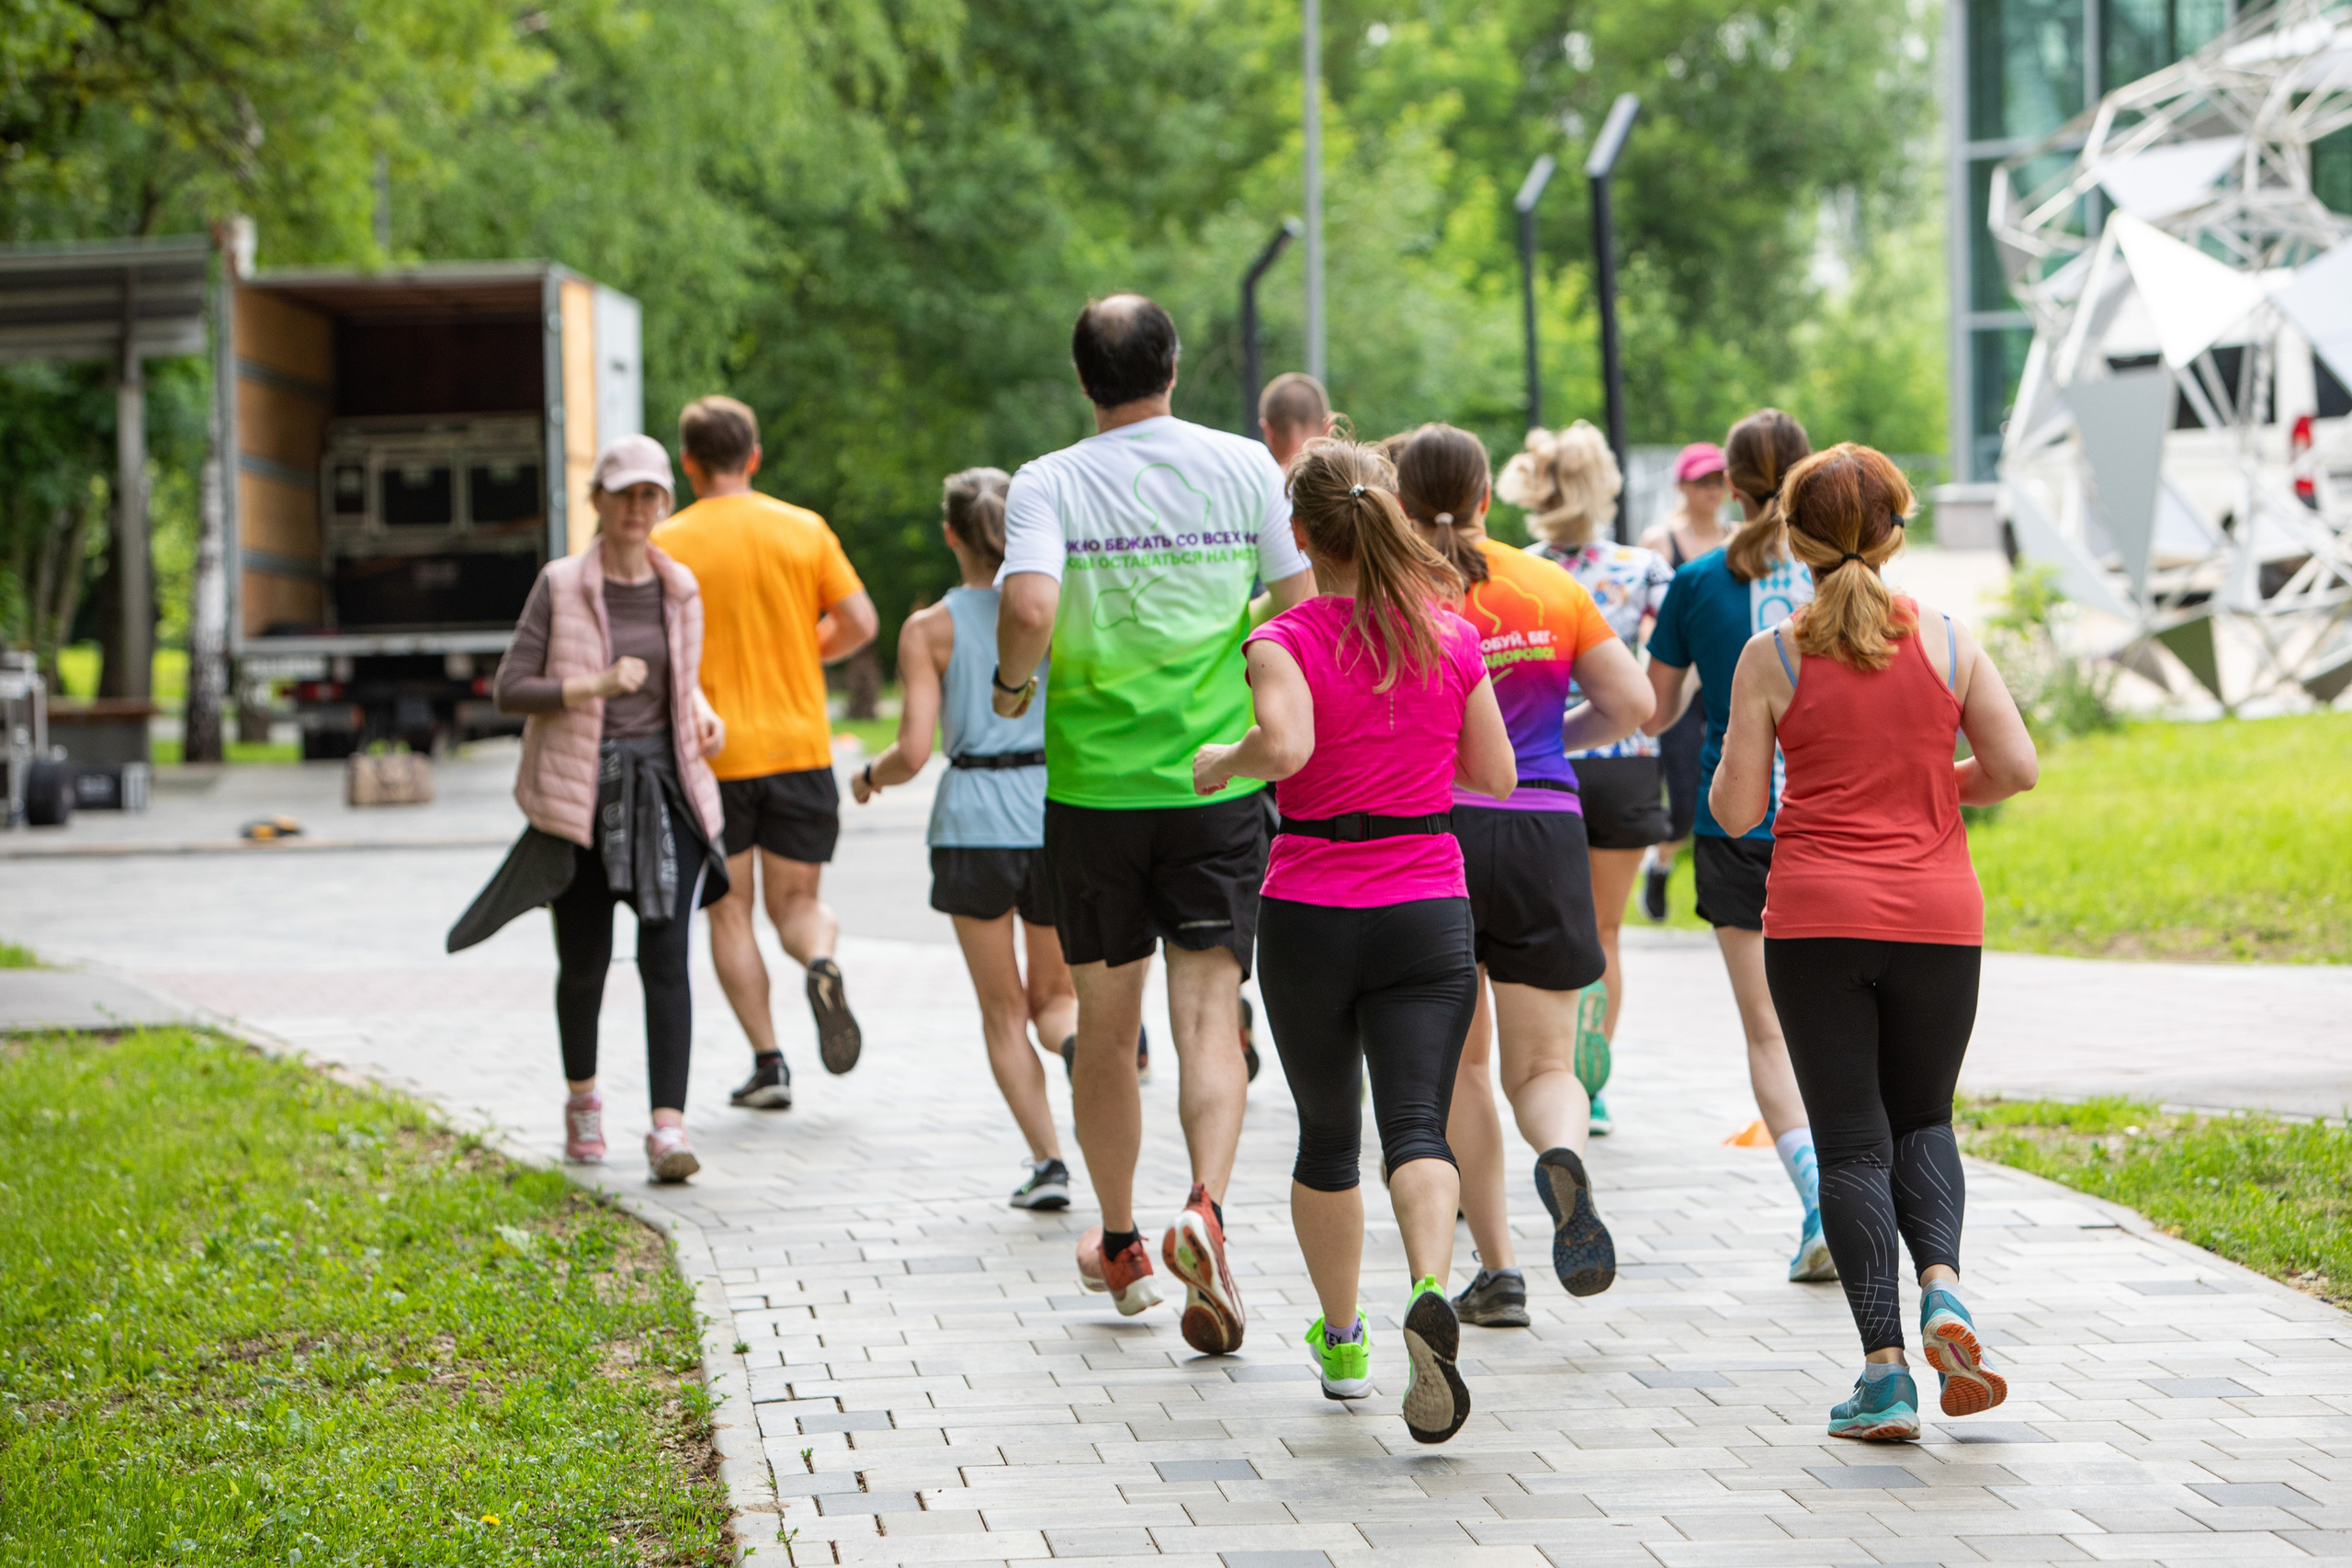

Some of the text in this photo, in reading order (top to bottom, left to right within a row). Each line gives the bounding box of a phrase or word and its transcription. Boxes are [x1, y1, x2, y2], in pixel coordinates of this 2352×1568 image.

[1104, 535, 1171, 552] БЕЖАТЬ
[1176, 534, 1198, 547] СО
[1203, 531, 1240, 545] ВСЕХ
[1097, 550, 1202, 569] ОСТАВАТЬСЯ
[1205, 550, 1228, 563] НА
[1527, 630, 1550, 645] БЕГ
